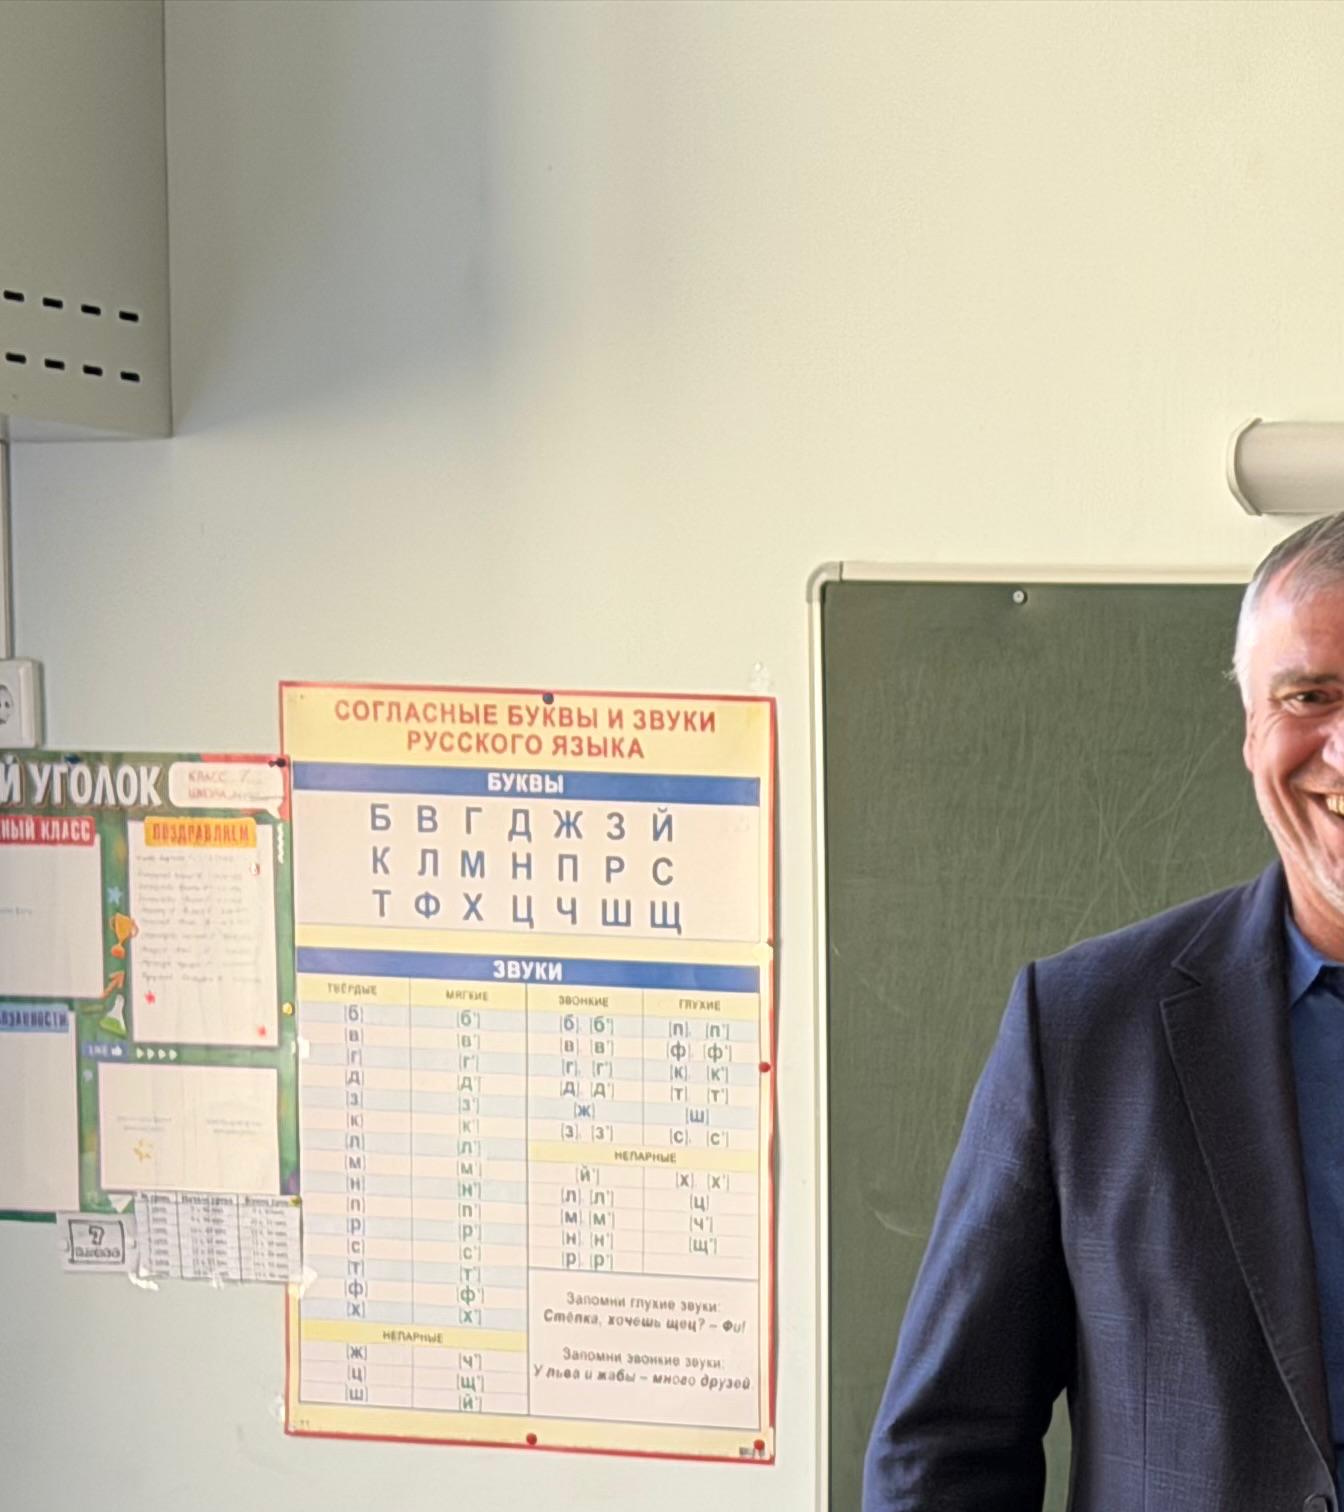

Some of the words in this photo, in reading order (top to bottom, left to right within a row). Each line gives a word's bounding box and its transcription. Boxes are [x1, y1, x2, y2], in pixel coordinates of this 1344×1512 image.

[335, 700, 498, 726] СОГЛАСНЫЕ
[509, 705, 598, 729] БУКВЫ
[609, 709, 623, 730] И
[633, 709, 716, 733] ЗВУКИ
[407, 731, 542, 757] РУССКОГО
[552, 735, 645, 759] ЯЗЫКА
[28, 763, 162, 806] УГОЛОК
[488, 772, 564, 793] БУКВЫ
[41, 822, 90, 841] КЛАСС
[370, 803, 391, 831] Б
[417, 806, 438, 833] В
[465, 807, 482, 834] Г
[508, 809, 532, 842] Д
[554, 811, 582, 838] Ж
[607, 812, 625, 840] З
[653, 808, 673, 842] Й
[152, 824, 248, 842] ПОЗДРАВЛЯЕМ
[373, 847, 390, 874] К
[417, 849, 438, 877] Л
[461, 851, 484, 878] М
[513, 853, 532, 880] Н
[558, 854, 578, 882] П
[606, 856, 625, 883] Р
[652, 858, 673, 886] С
[372, 890, 391, 917] Т
[415, 892, 440, 918] Ф
[463, 894, 483, 921] Х
[513, 896, 534, 929] Ц
[557, 897, 576, 925] Ч
[602, 899, 631, 926] Ш
[650, 901, 681, 935] Щ
[493, 959, 563, 982] ЗВУКИ
[328, 982, 377, 995] ТВЁРДЫЕ
[446, 990, 488, 1001] МЯГКИЕ
[559, 995, 609, 1007] ЗВОНКИЕ
[679, 999, 721, 1011] ГЛУХИЕ
[615, 1150, 676, 1163] НЕПАРНЫЕ
[566, 1291, 626, 1308] Запомни
[630, 1296, 675, 1311] глухие
[608, 1314, 661, 1329] хочешь
[383, 1331, 443, 1344] НЕПАРНЫЕ
[562, 1346, 622, 1364] Запомни
[626, 1352, 680, 1366] звонкие
[533, 1364, 544, 1377] У
[546, 1366, 580, 1380] льва
[584, 1369, 595, 1381] и
[597, 1368, 635, 1383] жабы
[653, 1373, 696, 1387] много
